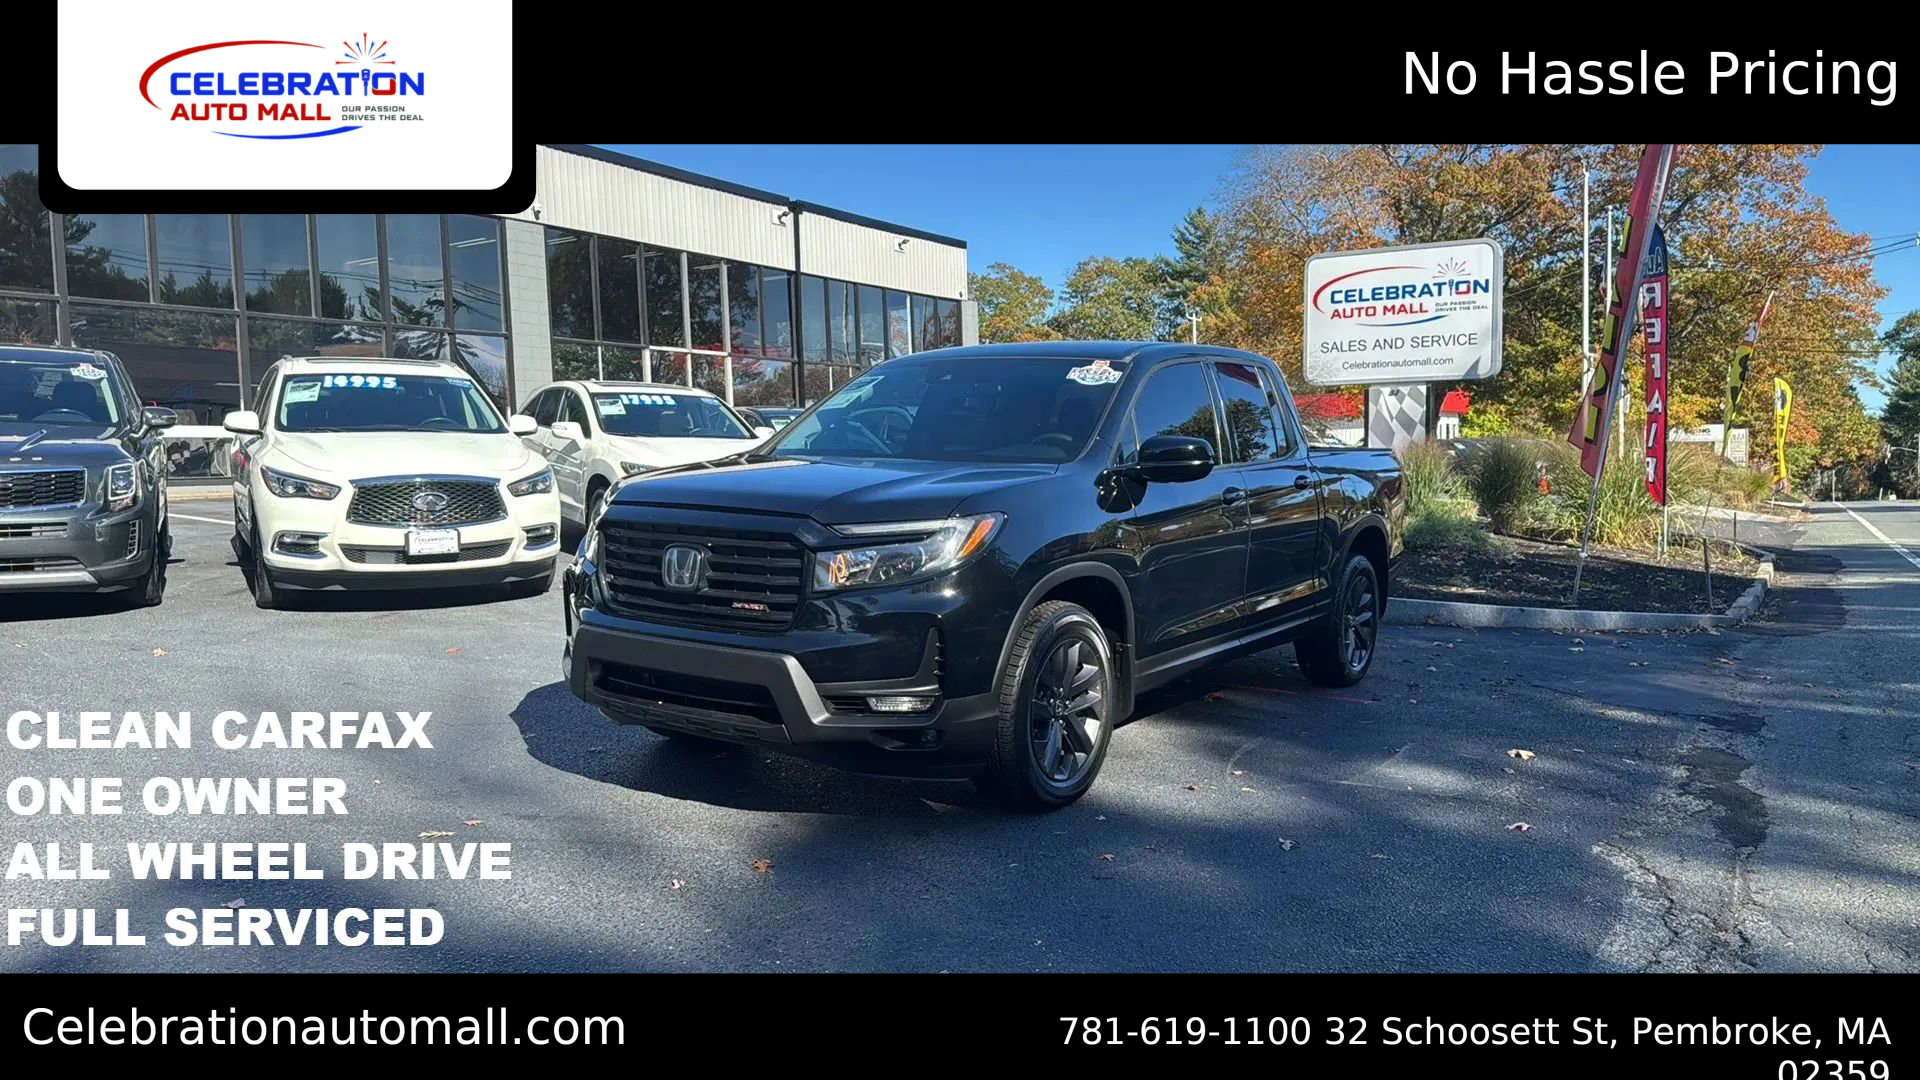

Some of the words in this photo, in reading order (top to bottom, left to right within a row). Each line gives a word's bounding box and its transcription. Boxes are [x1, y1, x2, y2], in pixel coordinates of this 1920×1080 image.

[1330, 279, 1490, 304] CELEBRATION
[1330, 305, 1377, 320] AUTO
[1382, 302, 1429, 316] MALL
[1320, 339, 1367, 354] SALES
[1372, 337, 1405, 351] AND
[1410, 333, 1478, 348] SERVICE
[1342, 357, 1454, 370] Celebrationautomall.com
[323, 375, 397, 389] 14995
